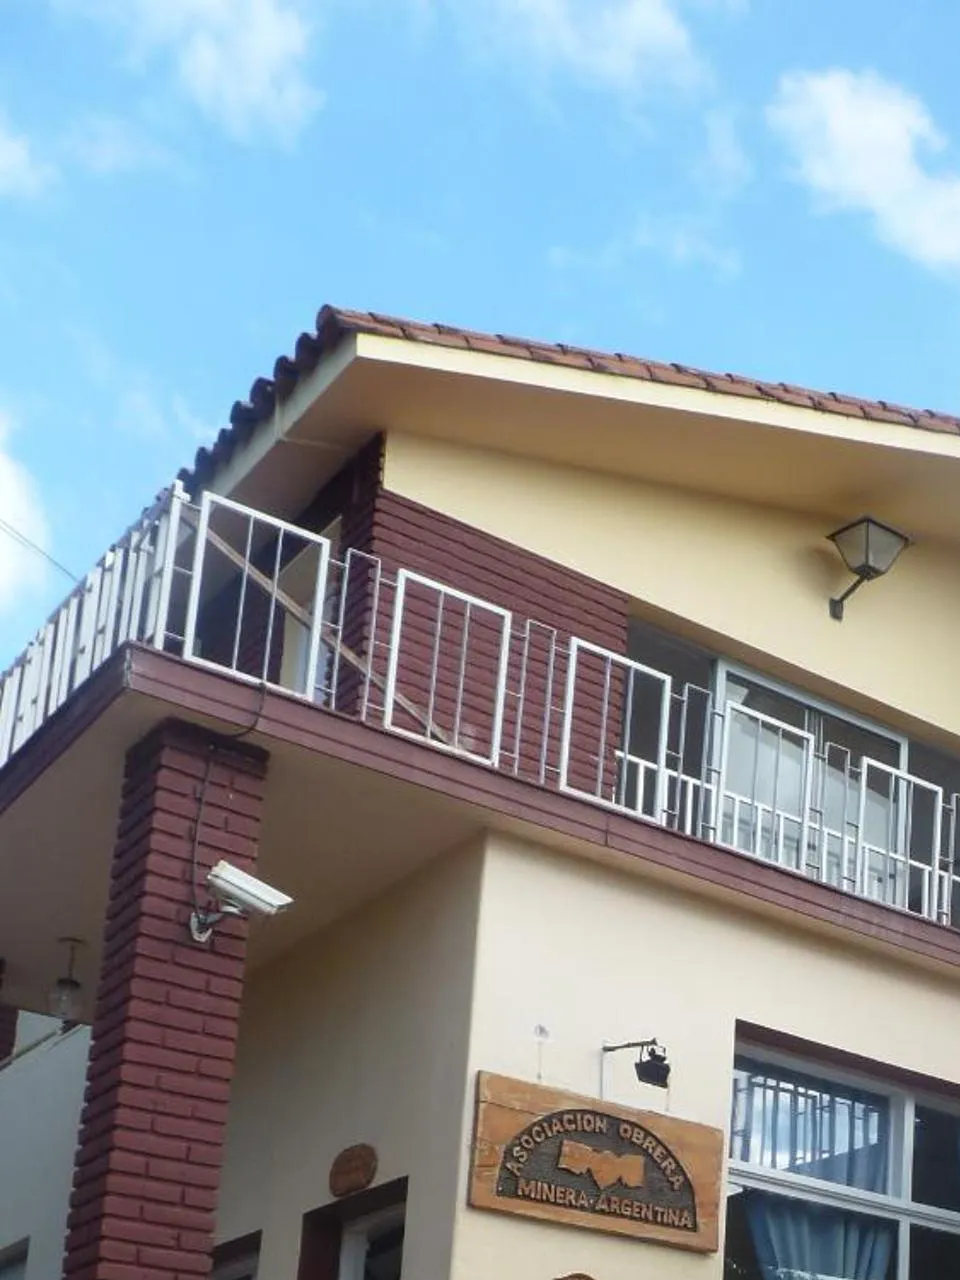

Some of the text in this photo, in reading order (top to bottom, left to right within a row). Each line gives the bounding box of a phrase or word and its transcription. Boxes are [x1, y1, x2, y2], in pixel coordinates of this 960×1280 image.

[504, 1112, 686, 1191] ASOCIACION OBRERA
[517, 1178, 694, 1229] MINERA ARGENTINA
